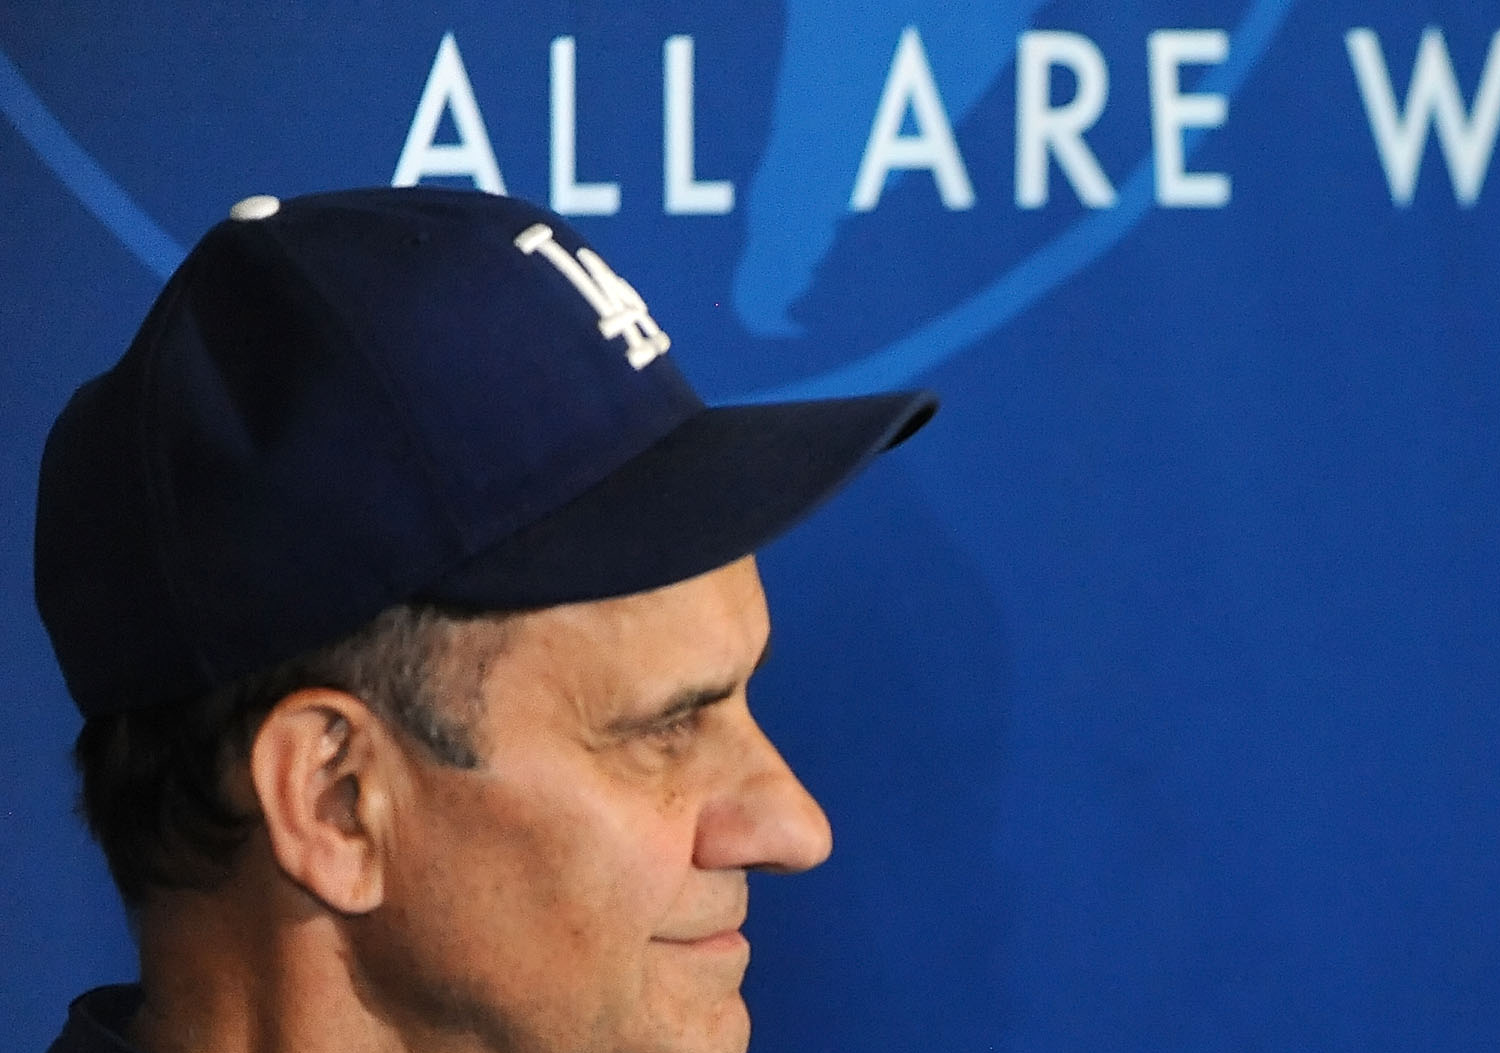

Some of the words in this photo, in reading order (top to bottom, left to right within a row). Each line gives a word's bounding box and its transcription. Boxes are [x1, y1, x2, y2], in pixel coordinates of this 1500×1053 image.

[391, 31, 735, 214] ALL
[849, 26, 1232, 209] ARE
[513, 222, 671, 371] LA
